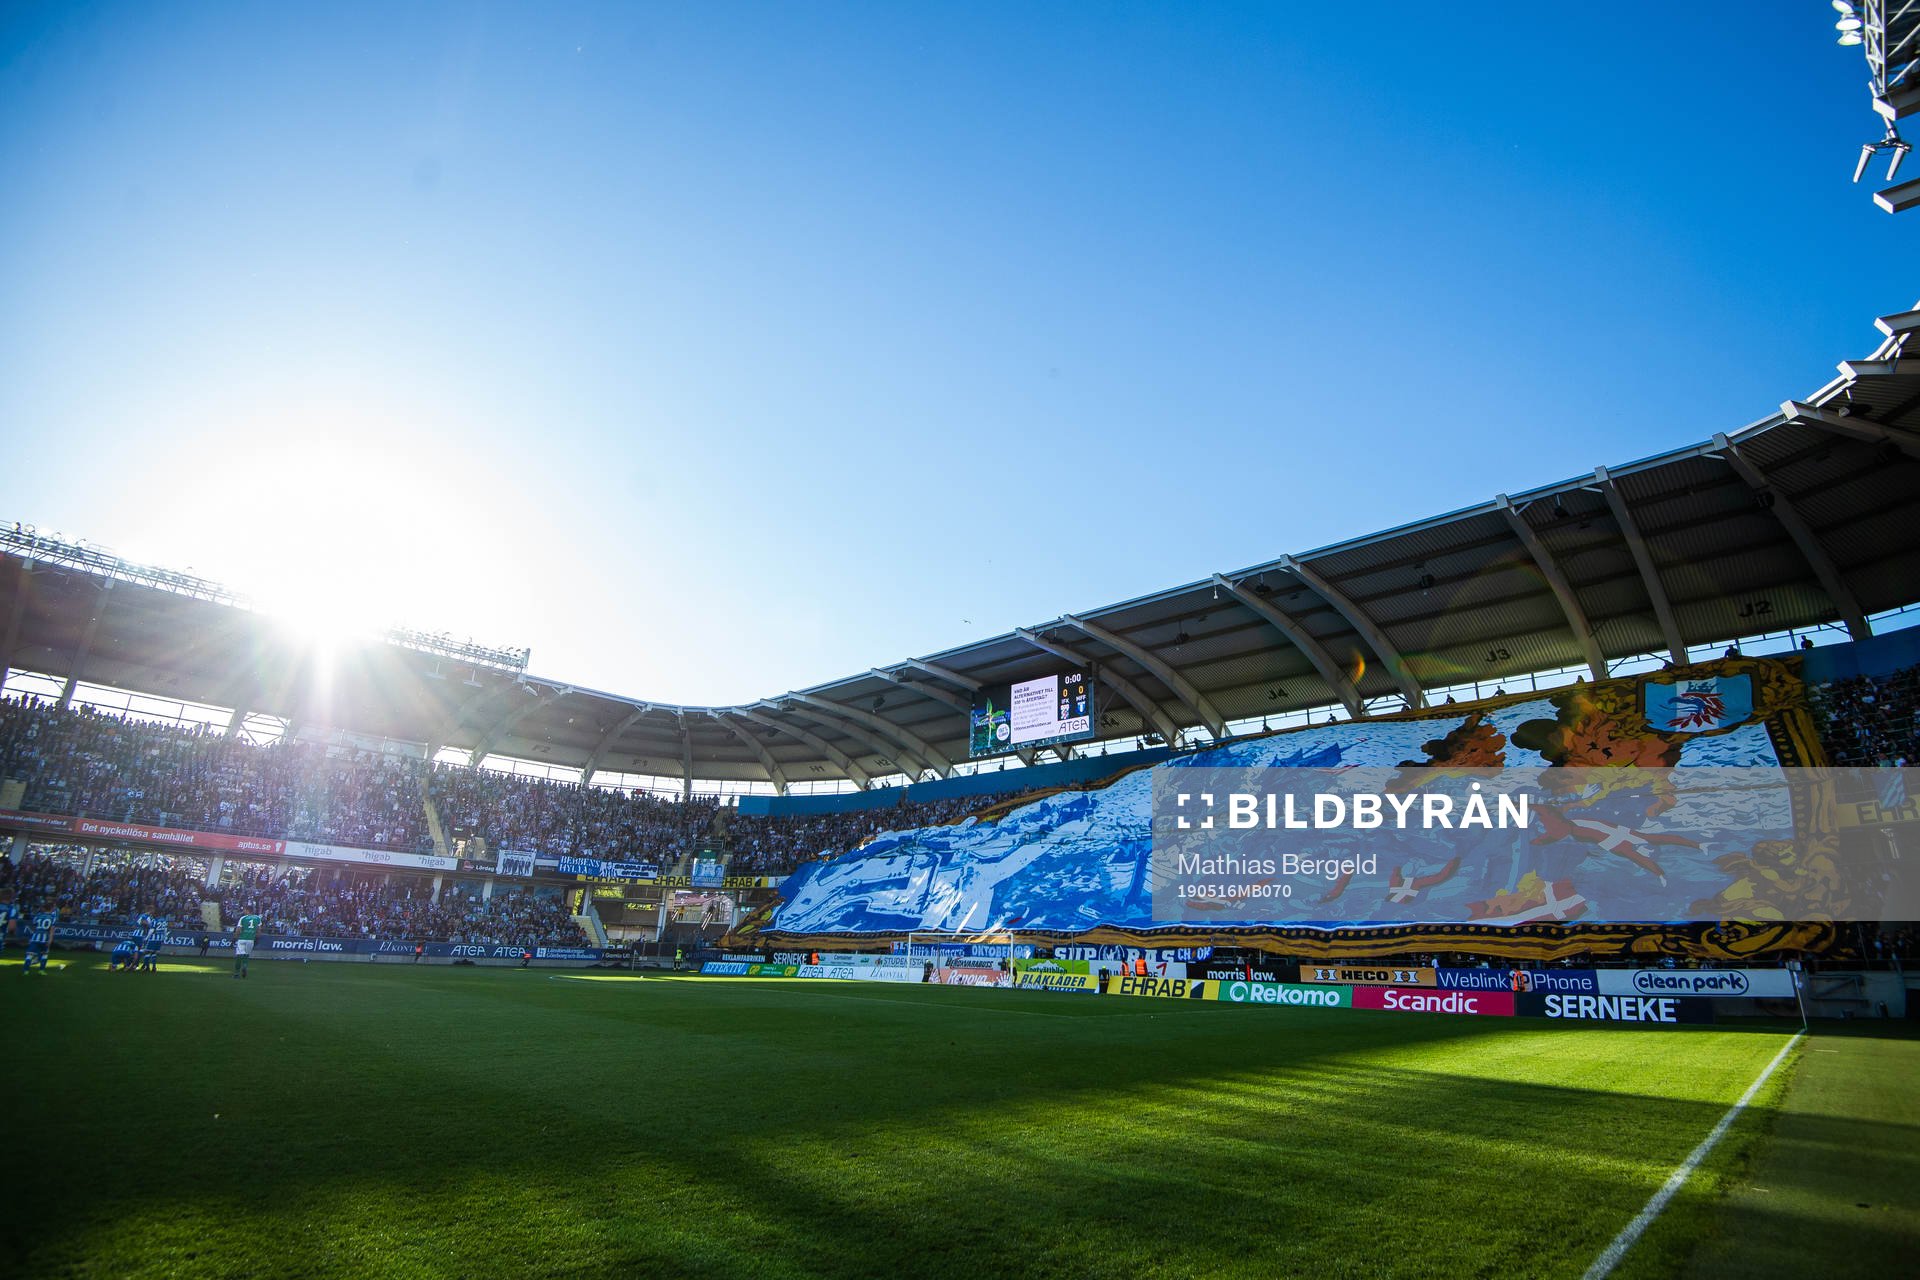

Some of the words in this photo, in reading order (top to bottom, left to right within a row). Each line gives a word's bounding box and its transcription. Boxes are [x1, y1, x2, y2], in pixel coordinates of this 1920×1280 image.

[1738, 601, 1773, 617] J2
[1486, 649, 1511, 662] J3
[1065, 674, 1081, 684] 0:00
[1062, 688, 1068, 697] 0
[1078, 685, 1084, 694] 0
[1058, 719, 1088, 733] ATEA
[82, 823, 97, 833] Det
[100, 826, 148, 838] nyckellösa
[152, 831, 194, 843] samhället
[238, 840, 271, 851] aptus.se
[364, 852, 391, 862] higab
[421, 857, 446, 867] higab
[36, 918, 51, 930] 10
[248, 919, 255, 929] 1
[773, 952, 807, 965] SERNEKE
[1341, 970, 1388, 982] HECO
[1439, 973, 1508, 989] Weblink
[1534, 973, 1592, 990] Phone
[1638, 973, 1690, 989] clean
[1693, 973, 1744, 992] park
[1120, 977, 1187, 997] EHRAB
[1250, 984, 1340, 1006] Rekomo
[1383, 990, 1478, 1014] Scandic
[1544, 994, 1677, 1022] SERNEKE
